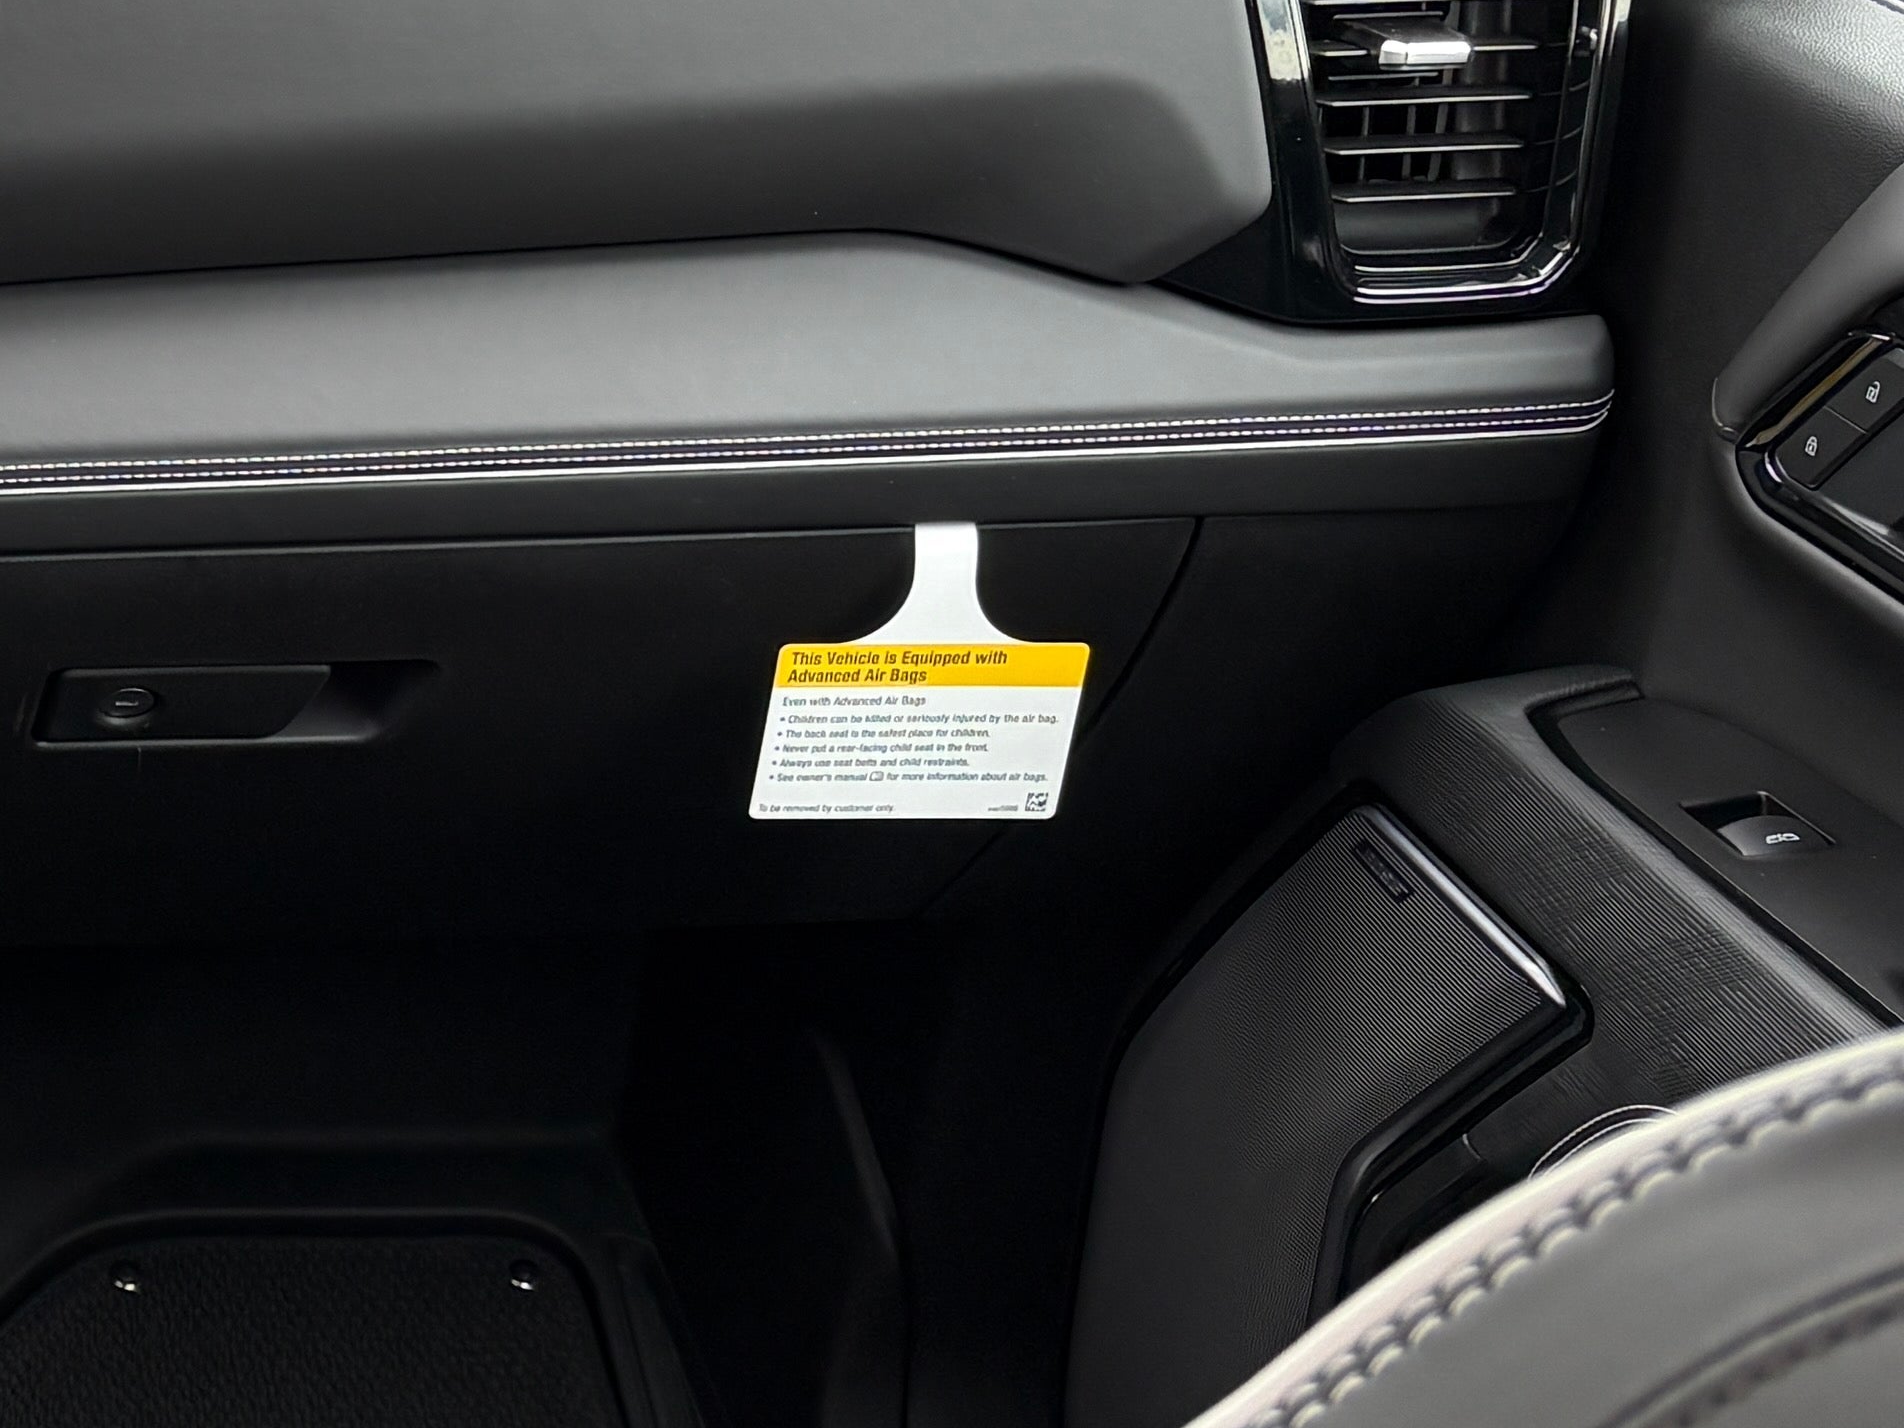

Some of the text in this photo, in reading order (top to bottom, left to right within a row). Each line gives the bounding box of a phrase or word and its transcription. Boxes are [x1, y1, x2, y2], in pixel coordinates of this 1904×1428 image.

[792, 651, 822, 665] This
[827, 651, 879, 665] Vehicle
[901, 650, 971, 667] Equipped
[975, 650, 1008, 665] with
[787, 668, 927, 685] Advanced Air Bags
[833, 696, 882, 706] Advanced
[884, 696, 899, 706] Air
[901, 695, 927, 707] Bags
[1004, 714, 1020, 723] the
